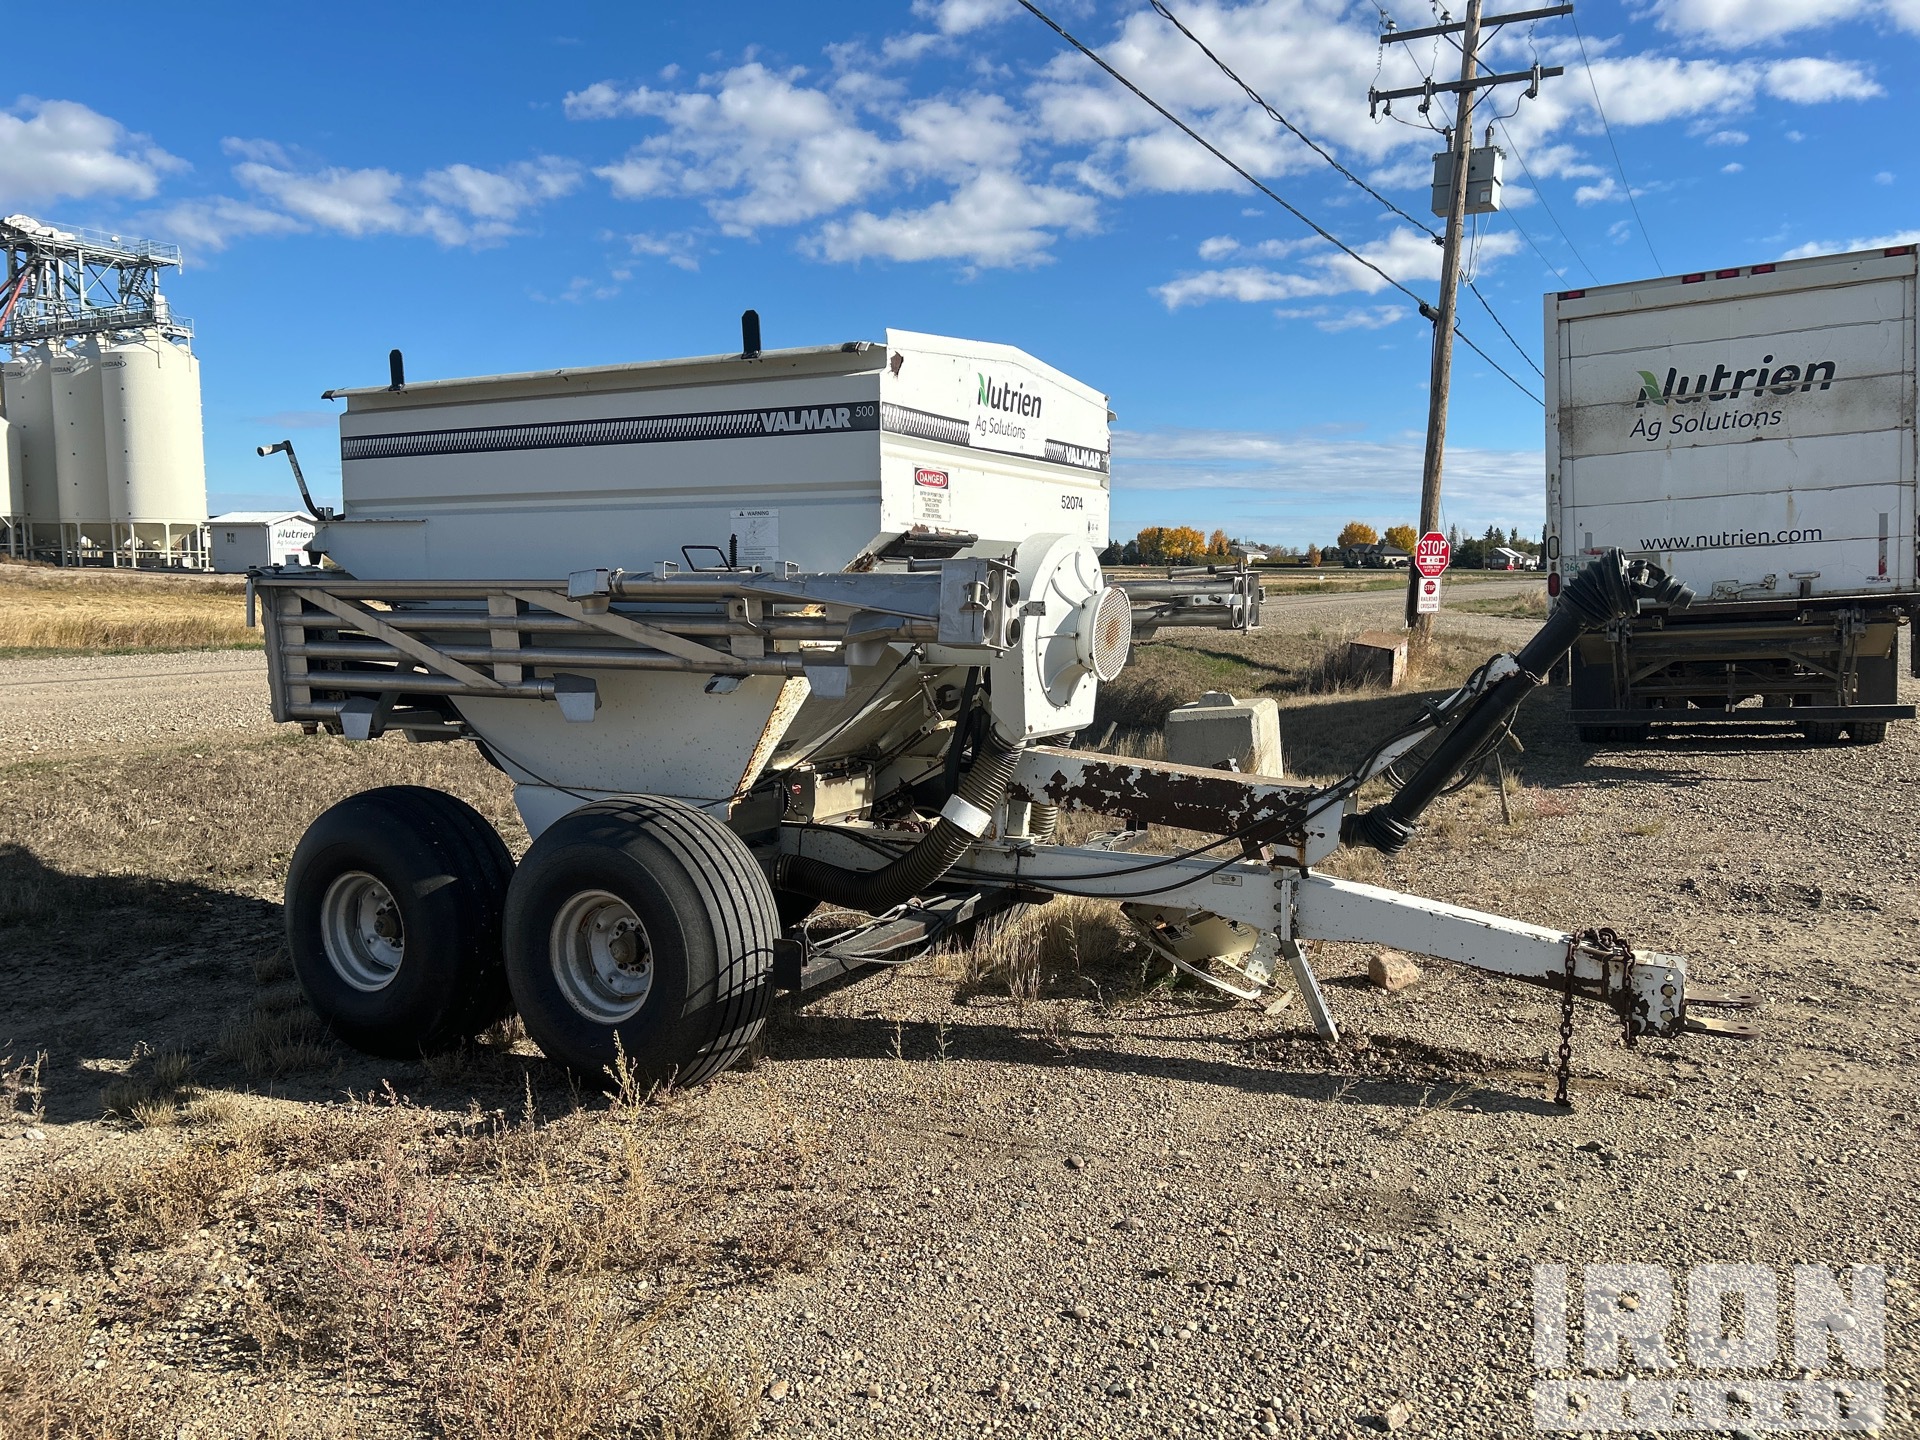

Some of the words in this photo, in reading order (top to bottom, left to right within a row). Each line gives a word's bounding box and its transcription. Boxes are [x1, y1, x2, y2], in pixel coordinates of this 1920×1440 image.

[1635, 354, 1836, 409] Nutrien
[977, 372, 1042, 418] Nutrien
[760, 407, 851, 433] VALMAR
[855, 405, 875, 418] 500
[975, 414, 987, 437] Ag
[988, 417, 1026, 440] Solutions
[1629, 418, 1662, 442] Ag
[1669, 409, 1783, 435] Solutions
[1065, 445, 1101, 470] VALMAR
[919, 472, 944, 485] DANGER
[1061, 495, 1083, 510] 52074
[277, 528, 314, 539] Nutrien
[1640, 528, 1822, 550] www.nutrien.com
[1420, 540, 1447, 555] STOP
